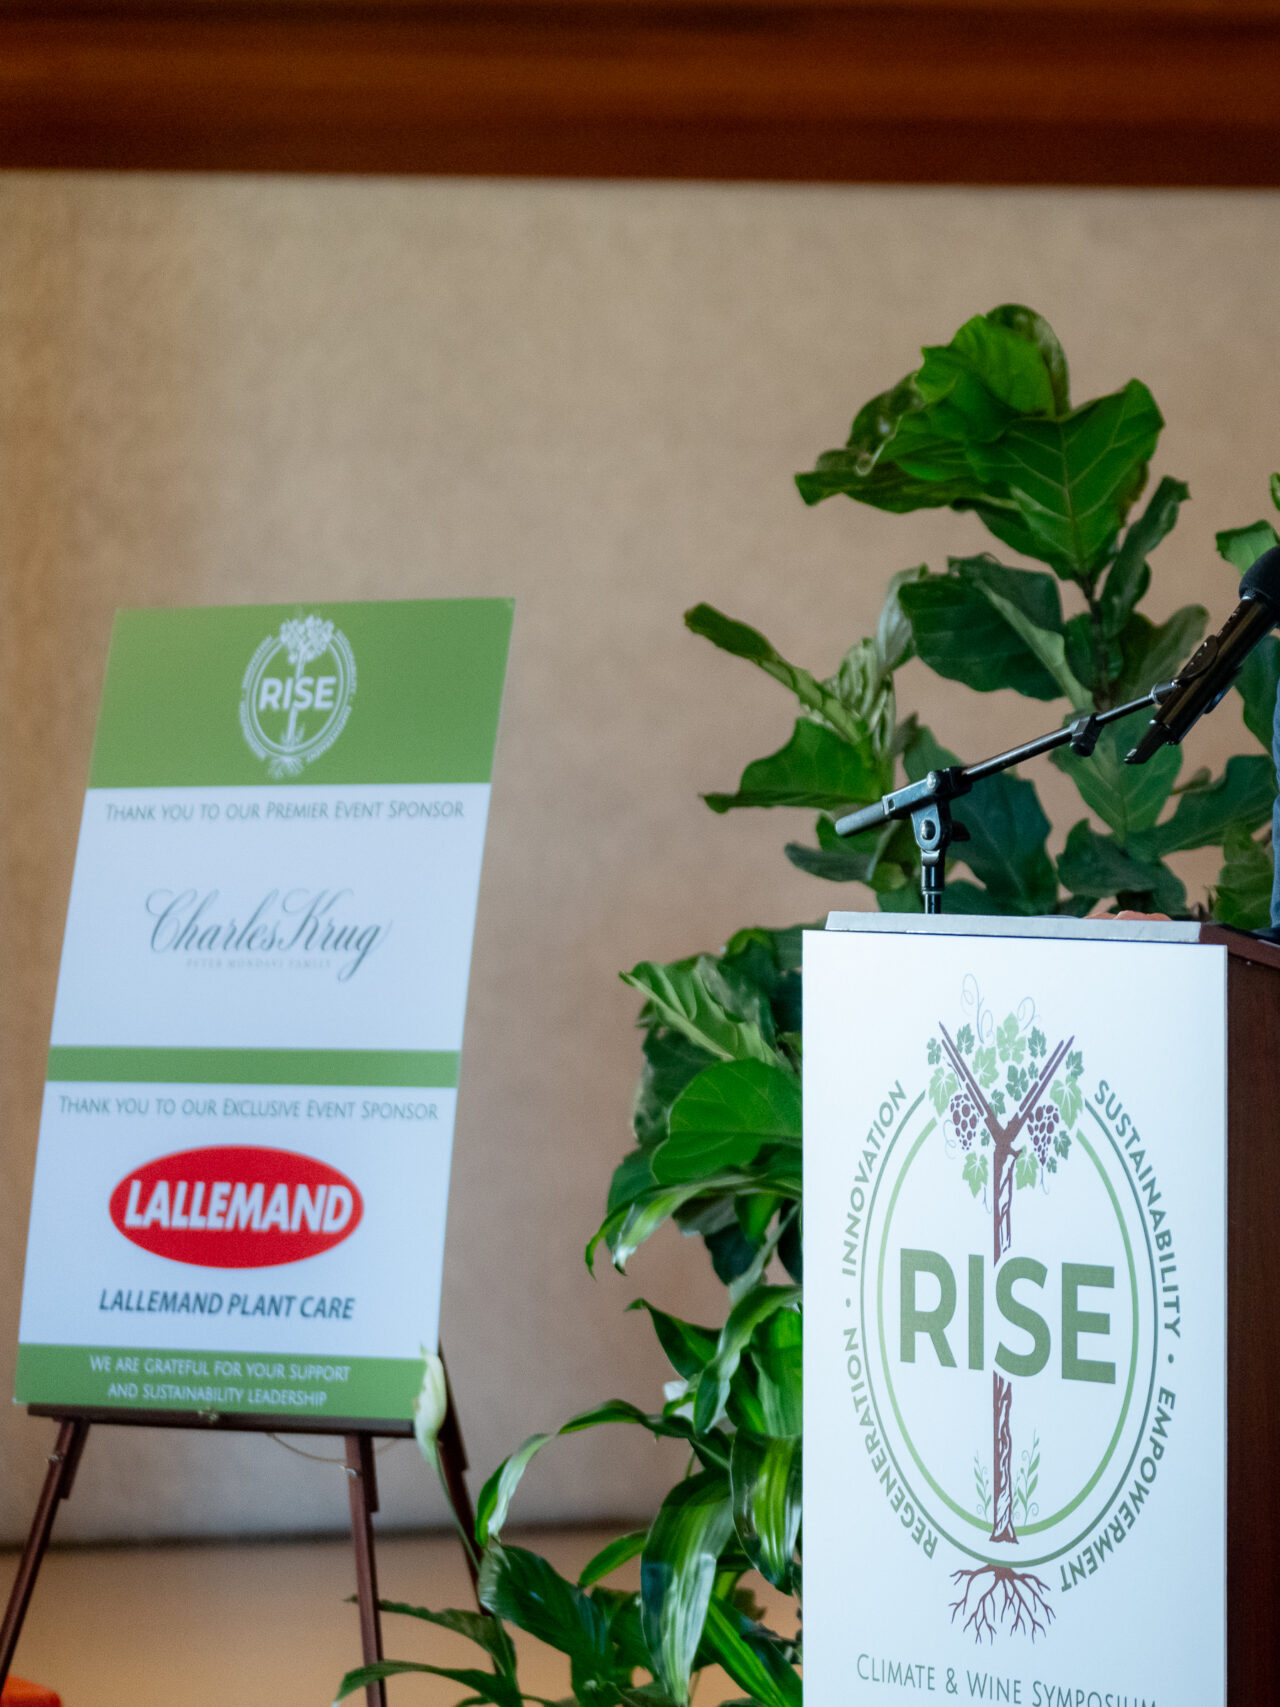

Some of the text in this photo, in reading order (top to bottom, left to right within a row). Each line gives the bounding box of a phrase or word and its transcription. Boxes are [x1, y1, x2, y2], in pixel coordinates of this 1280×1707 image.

[258, 676, 337, 711] RISE
[105, 801, 465, 822] THANK YOU TO OUR PREMIER EVENT SPONSOR
[145, 888, 393, 984] Charles Krug
[59, 1095, 438, 1121] THANK YOU TO OUR EXCLUSIVE EVENT SPONSOR
[841, 1080, 908, 1277] INNOVATION
[123, 1179, 353, 1233] LALLEMAND
[1093, 1080, 1182, 1339] SUSTAINABILITY
[99, 1288, 355, 1319] LALLEMAND PLANT CARE
[900, 1248, 1116, 1385] RISE
[90, 1355, 351, 1382] WE ARE GRATEFUL FOR YOUR SUPPORT
[108, 1382, 328, 1407] AND SUSTAINABILITY LEADERSHIP
[842, 1328, 939, 1560] REGENERATION
[1060, 1386, 1177, 1592] EMPOWERMENT
[856, 1653, 936, 1692] CLIMATE
[945, 1668, 959, 1695] &
[966, 1671, 1022, 1705] WINE
